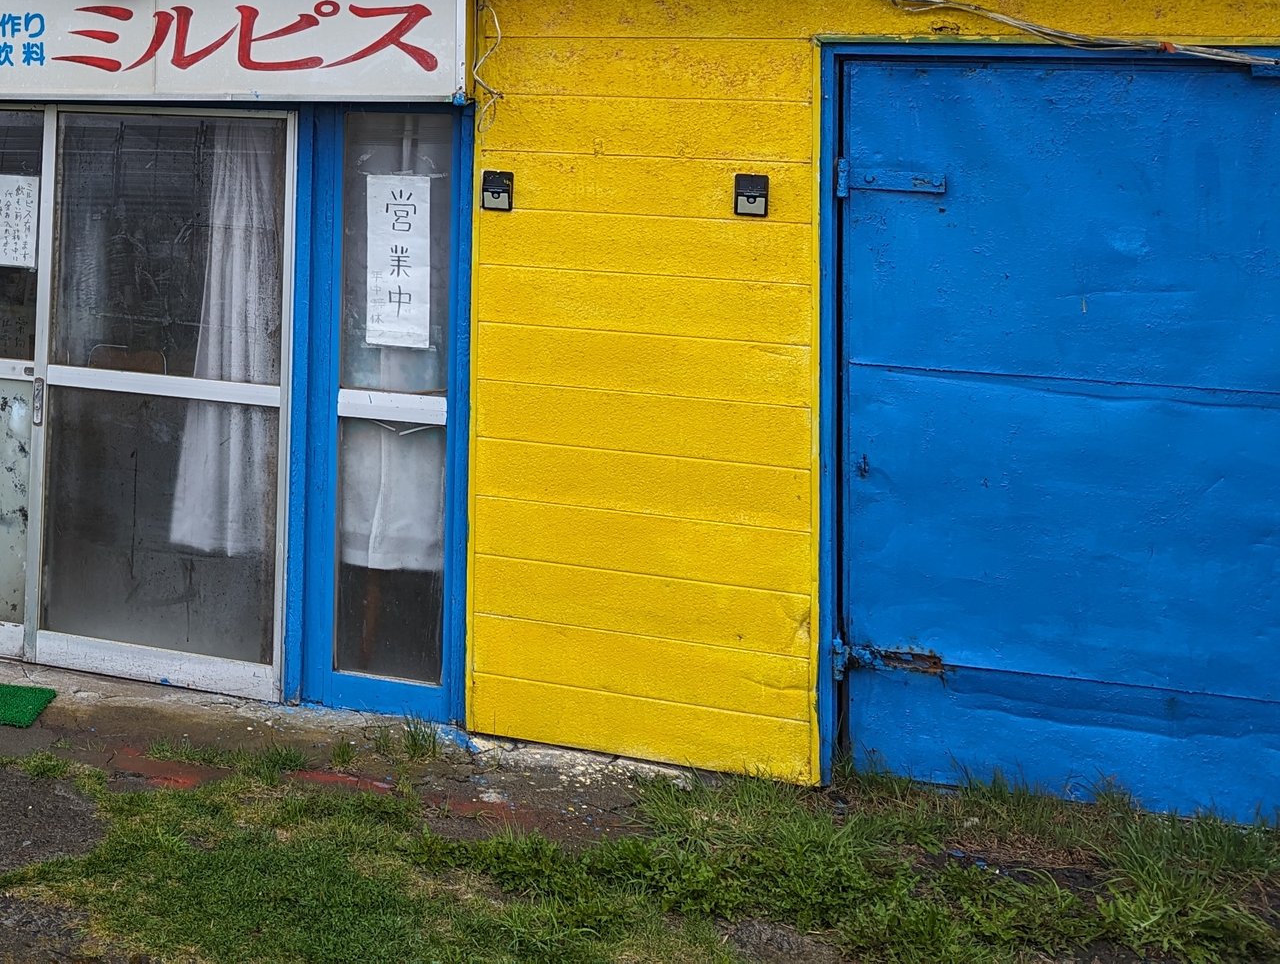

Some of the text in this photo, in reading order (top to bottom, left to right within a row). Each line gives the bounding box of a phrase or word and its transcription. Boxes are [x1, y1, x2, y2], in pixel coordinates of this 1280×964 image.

[51, 0, 439, 73] ミルピス
[385, 189, 417, 318] 営業中
